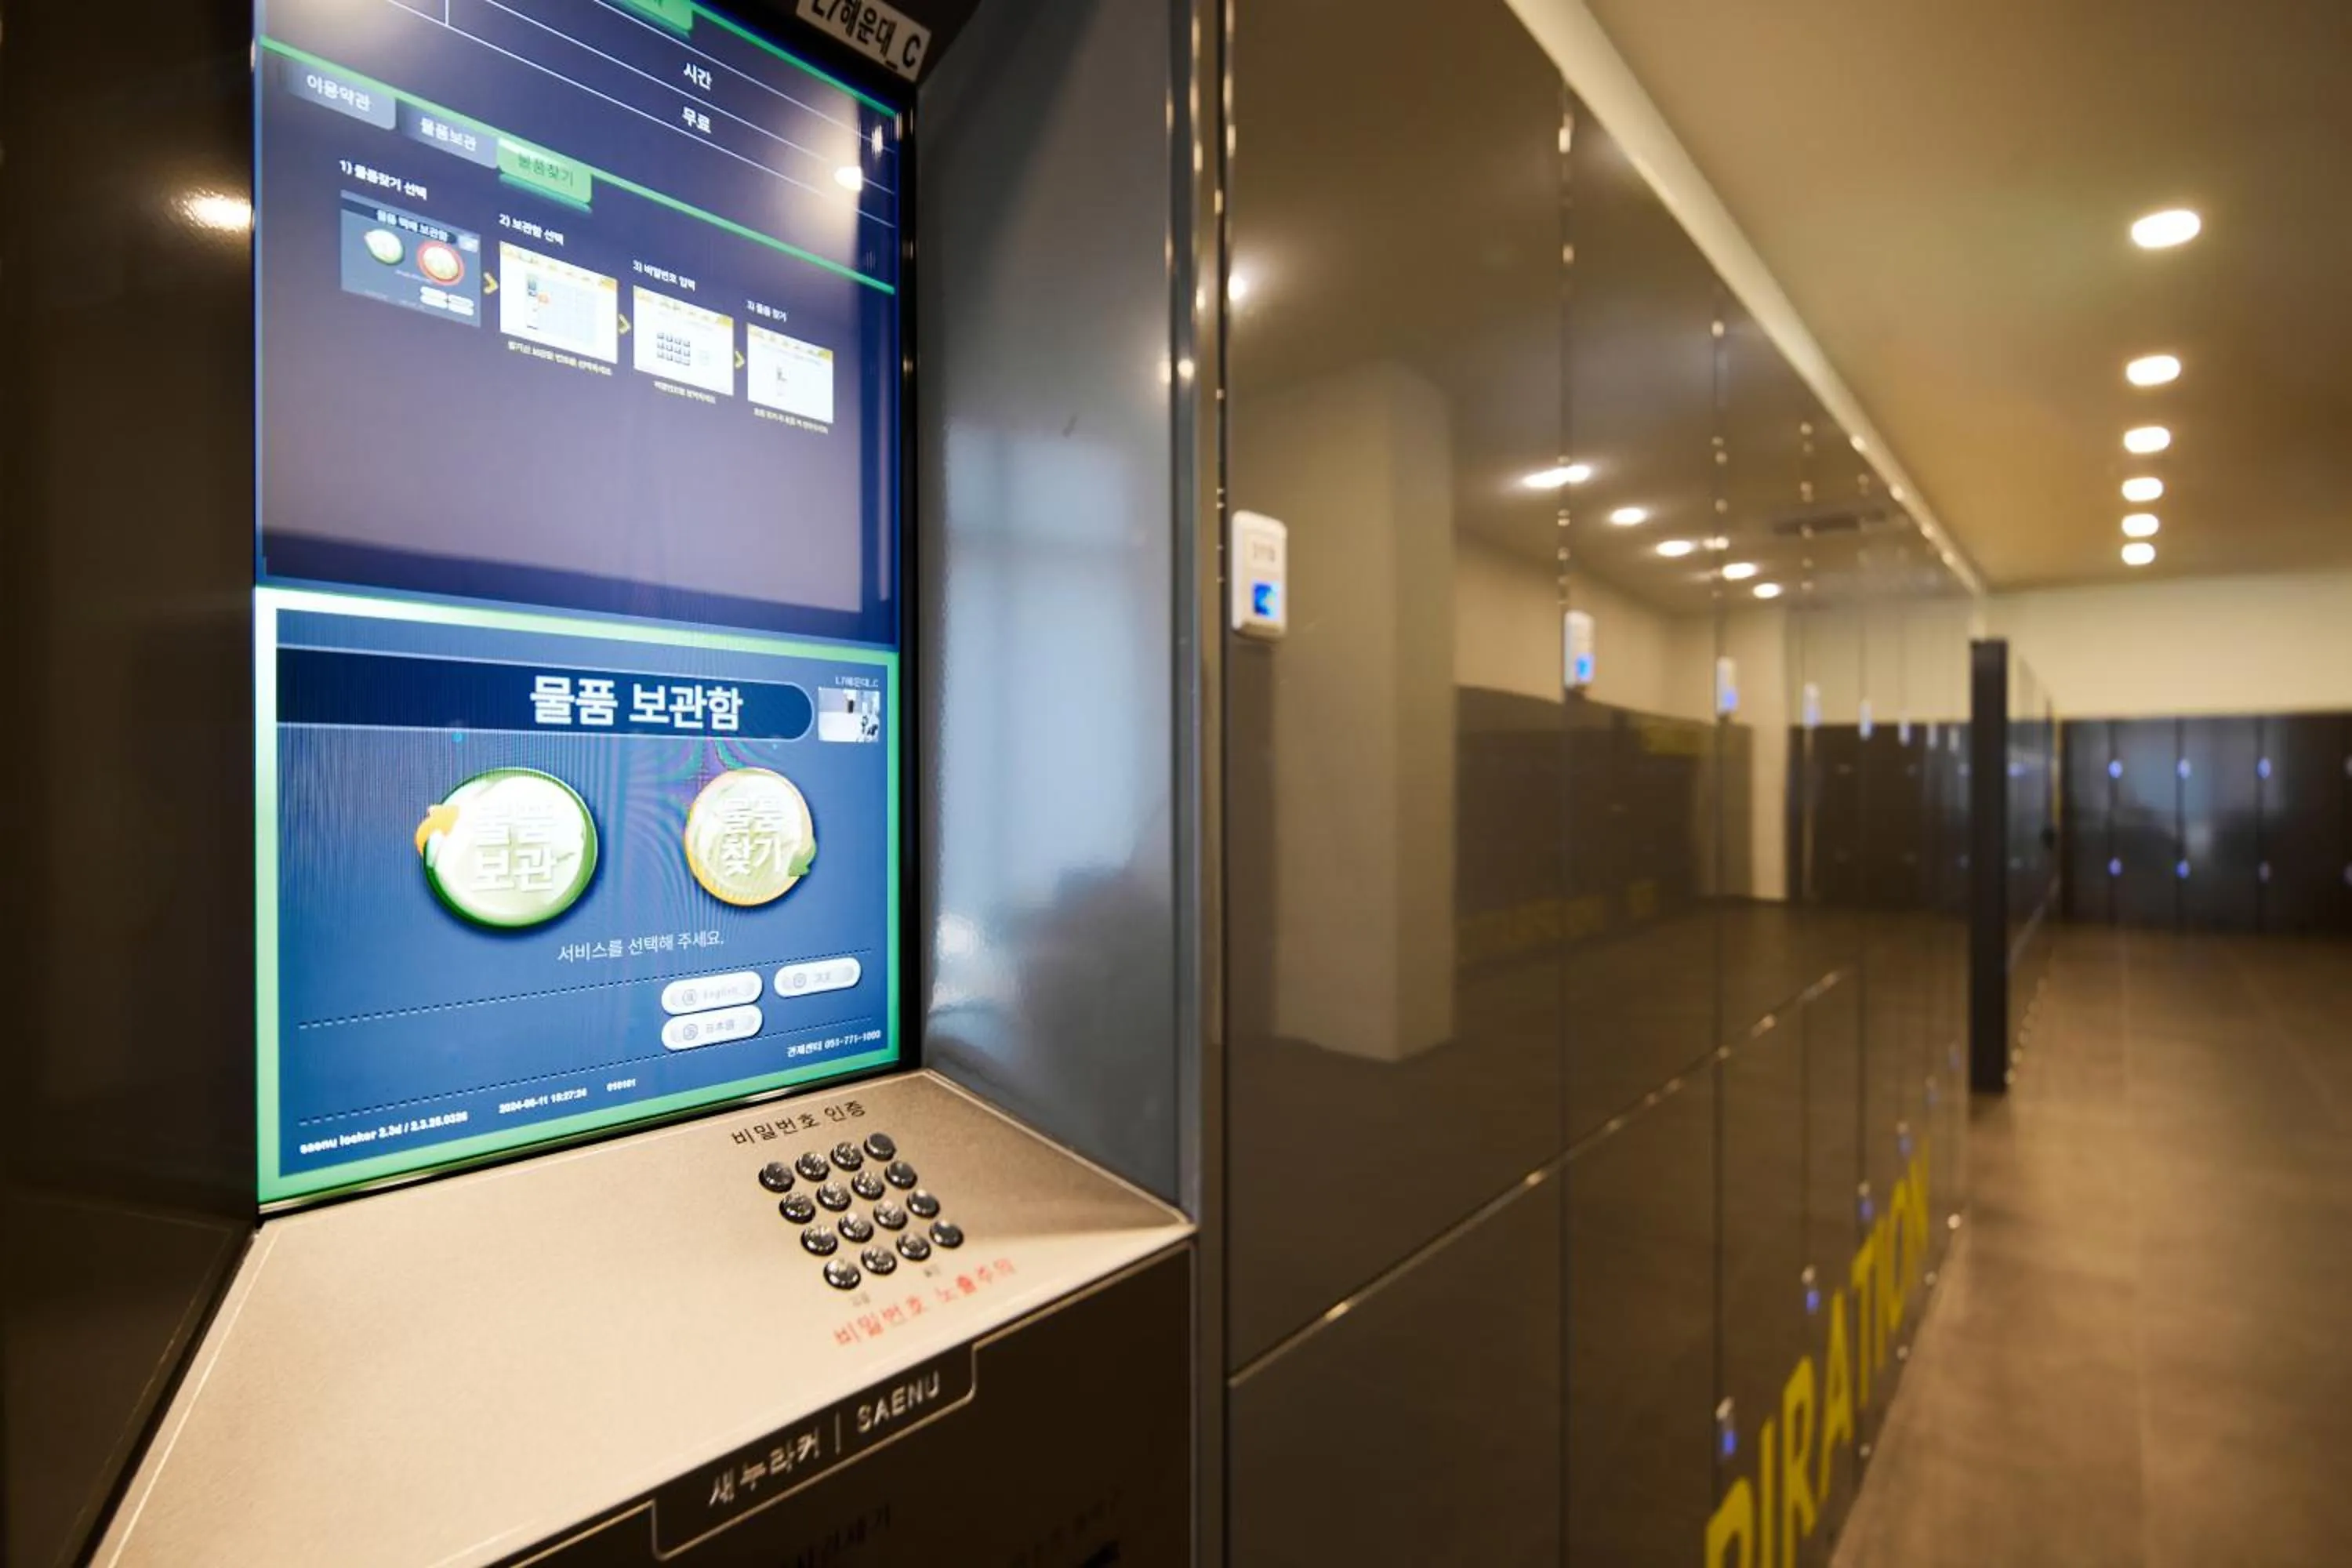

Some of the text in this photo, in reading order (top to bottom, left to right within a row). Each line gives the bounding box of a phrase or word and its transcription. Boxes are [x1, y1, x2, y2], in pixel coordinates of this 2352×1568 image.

[307, 74, 372, 112] 이용약관
[684, 62, 713, 90] 시간
[420, 117, 477, 152] 물품보관
[681, 106, 711, 134] 무료
[530, 675, 743, 731] 물품 보관함
[471, 847, 561, 892] 보관
[722, 834, 782, 877] 찾기
[558, 930, 724, 963] 서비스를 선택해 주세요.
[731, 1100, 866, 1145] 비밀번호 인증
[833, 1294, 927, 1346] 비밀번호
[709, 1370, 941, 1506] 새누라커 SAENU
